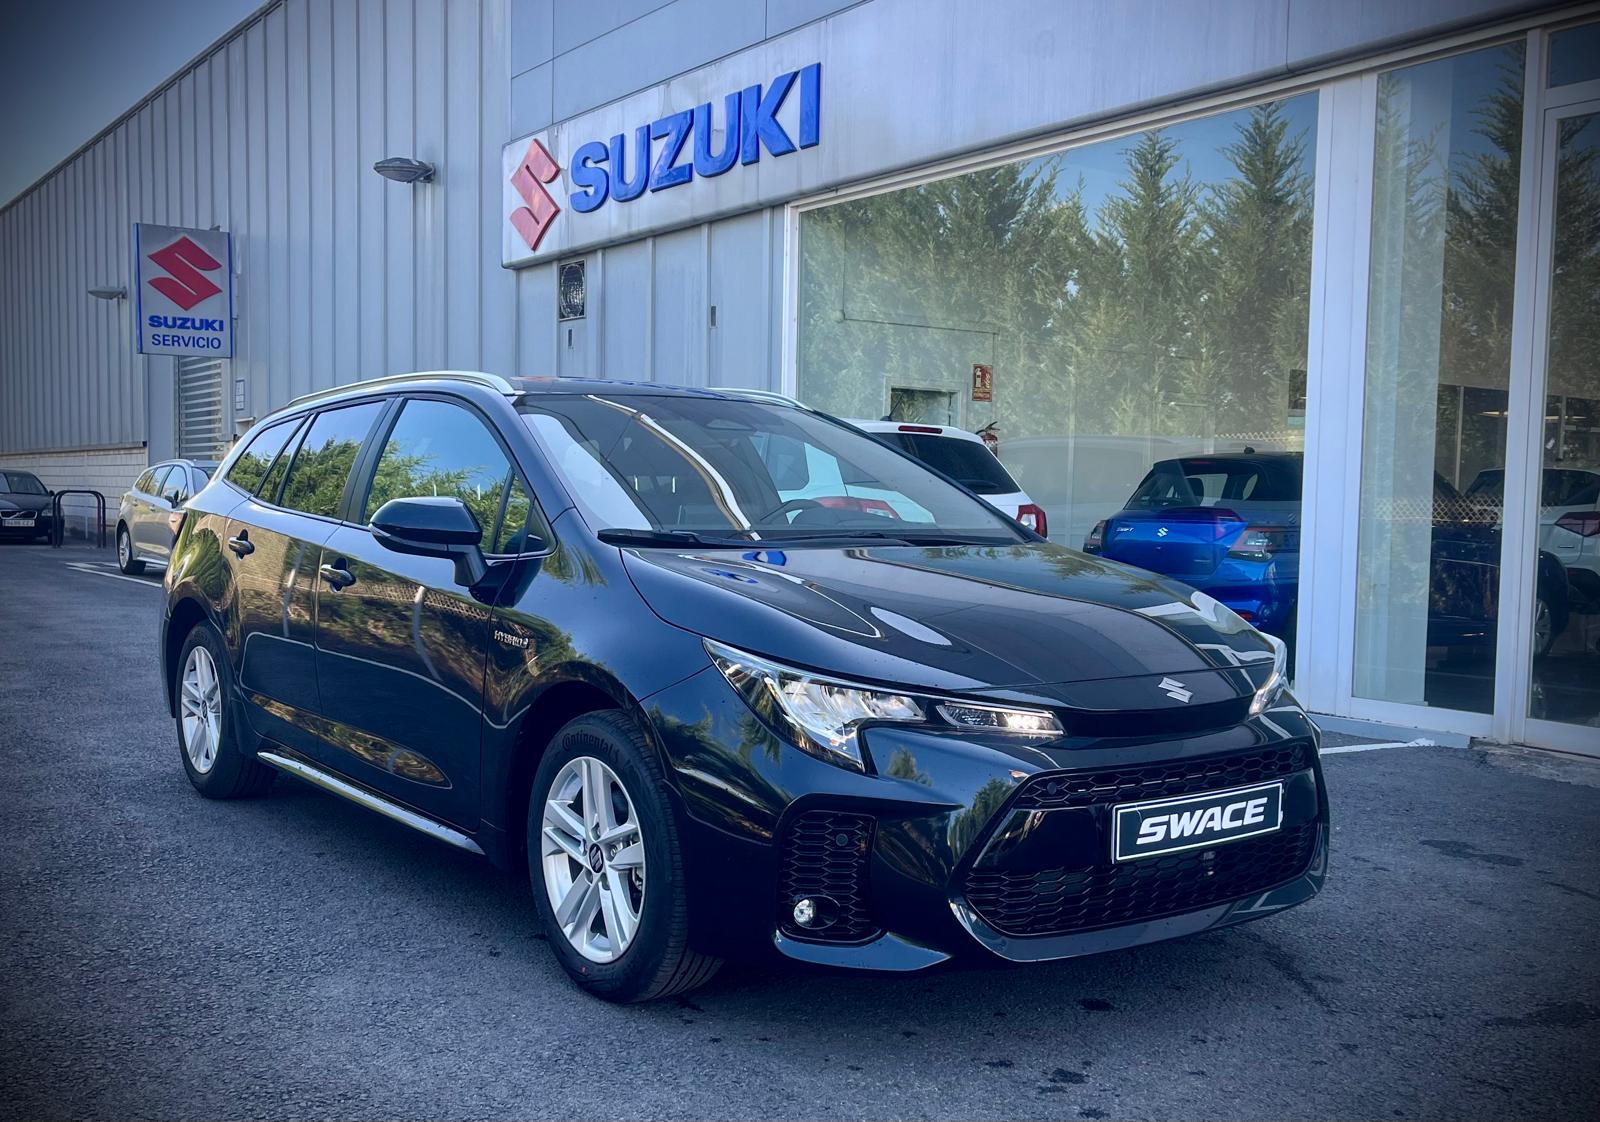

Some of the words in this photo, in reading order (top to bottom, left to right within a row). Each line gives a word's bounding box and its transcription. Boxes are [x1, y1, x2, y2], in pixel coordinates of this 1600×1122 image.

[569, 62, 821, 213] SUZUKI
[148, 315, 224, 331] SUZUKI
[152, 334, 221, 349] SERVICIO
[562, 730, 614, 756] Continental
[1136, 797, 1268, 845] SWACE
